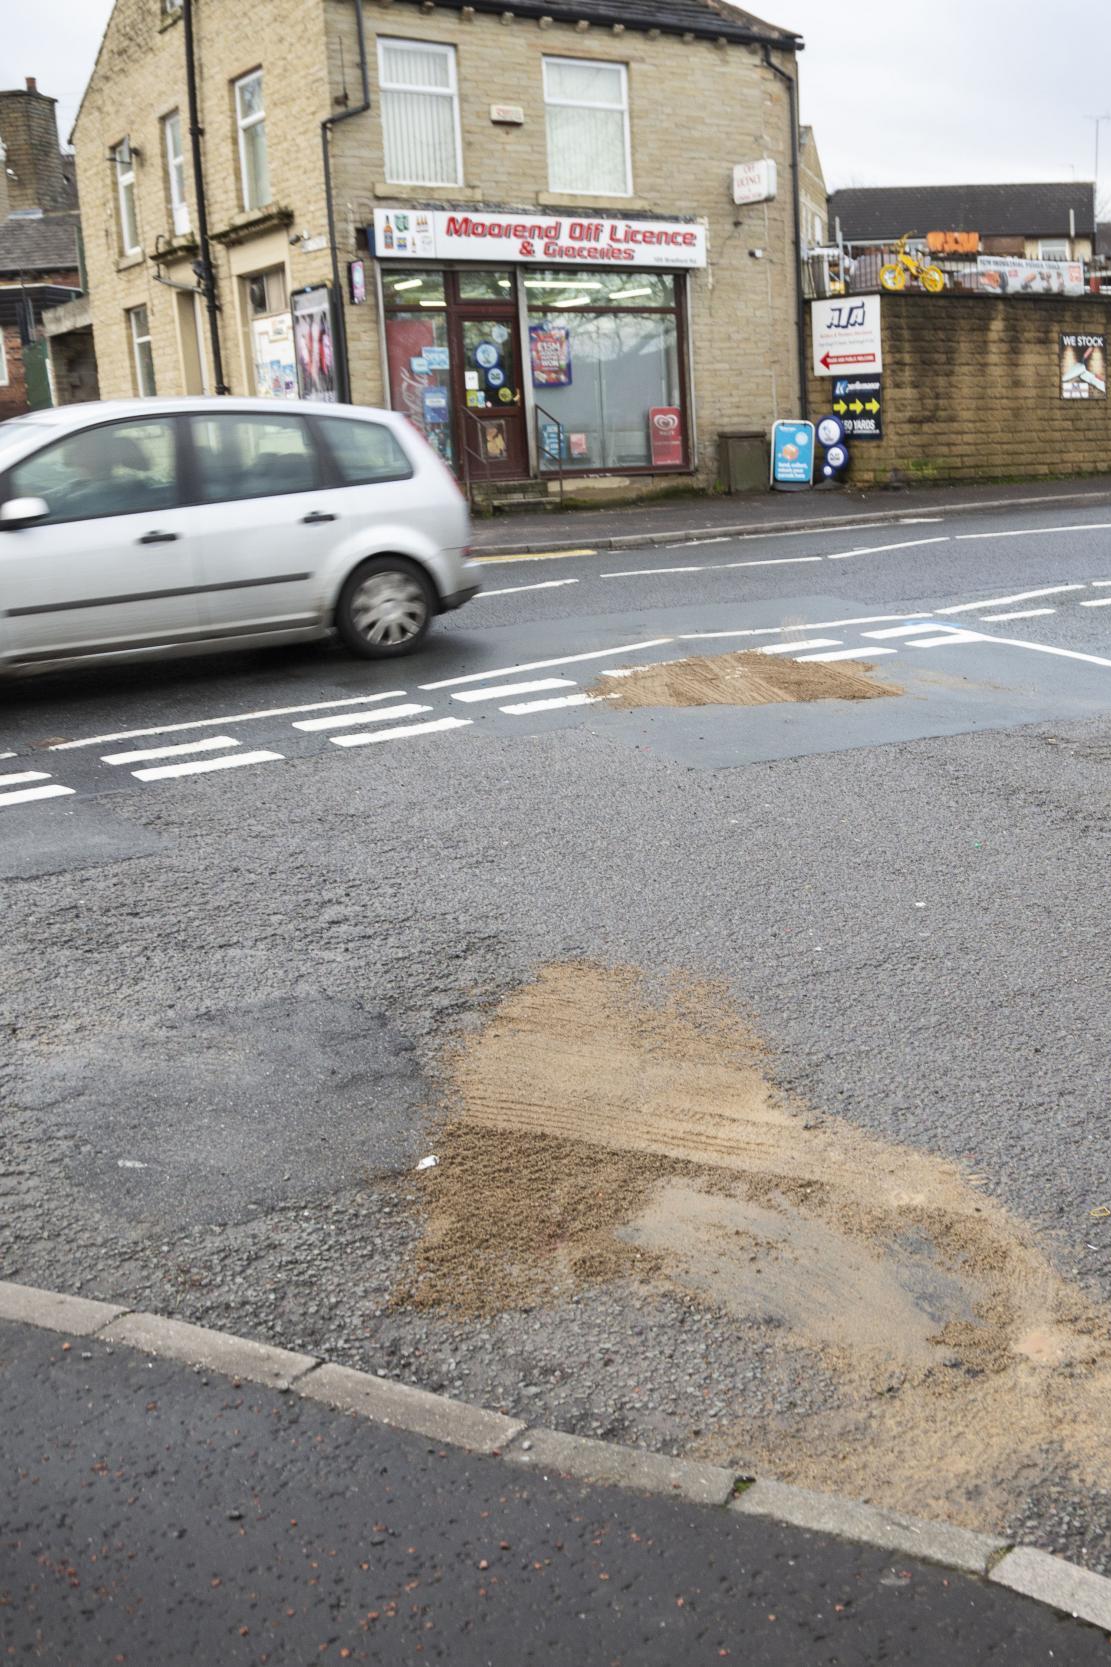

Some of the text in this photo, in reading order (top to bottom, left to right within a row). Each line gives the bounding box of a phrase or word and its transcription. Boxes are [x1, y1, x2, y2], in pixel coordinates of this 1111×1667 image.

[446, 217, 697, 247] Moorend Off Licence
[519, 241, 535, 256] &
[543, 242, 635, 261] Groceries
[1063, 335, 1104, 347] WE STOCK
[853, 418, 876, 431] YARDS
